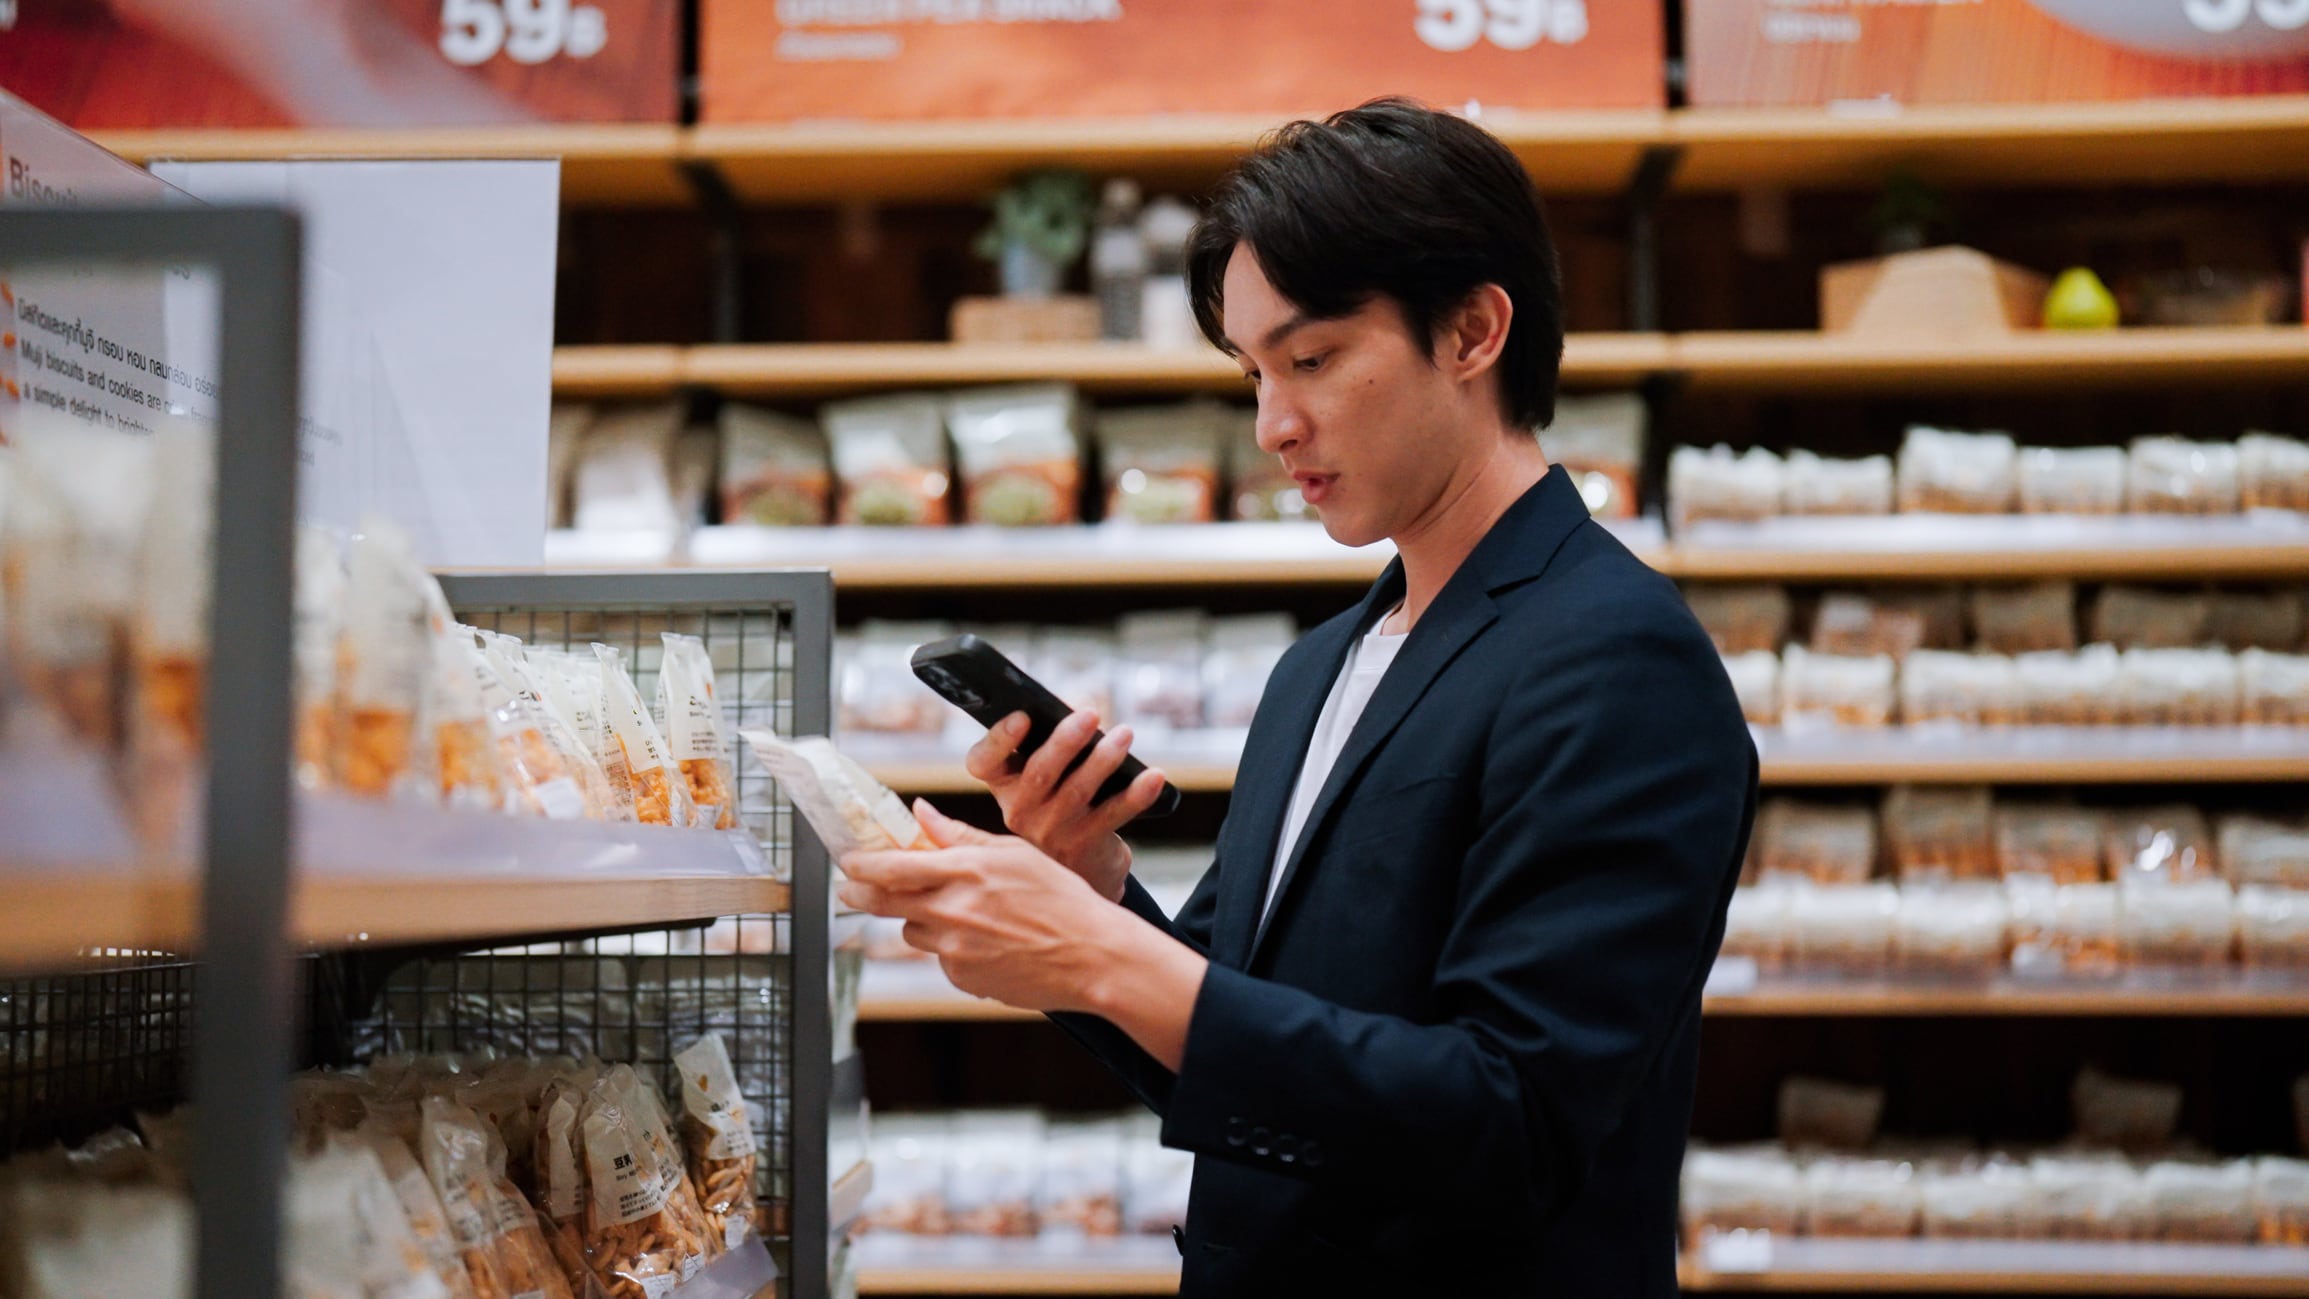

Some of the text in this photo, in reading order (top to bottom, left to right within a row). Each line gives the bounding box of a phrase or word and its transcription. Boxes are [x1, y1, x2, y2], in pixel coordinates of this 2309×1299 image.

[46, 350, 85, 383] biscuits
[87, 369, 105, 391] and
[108, 379, 145, 406] cookies
[147, 393, 161, 411] are
